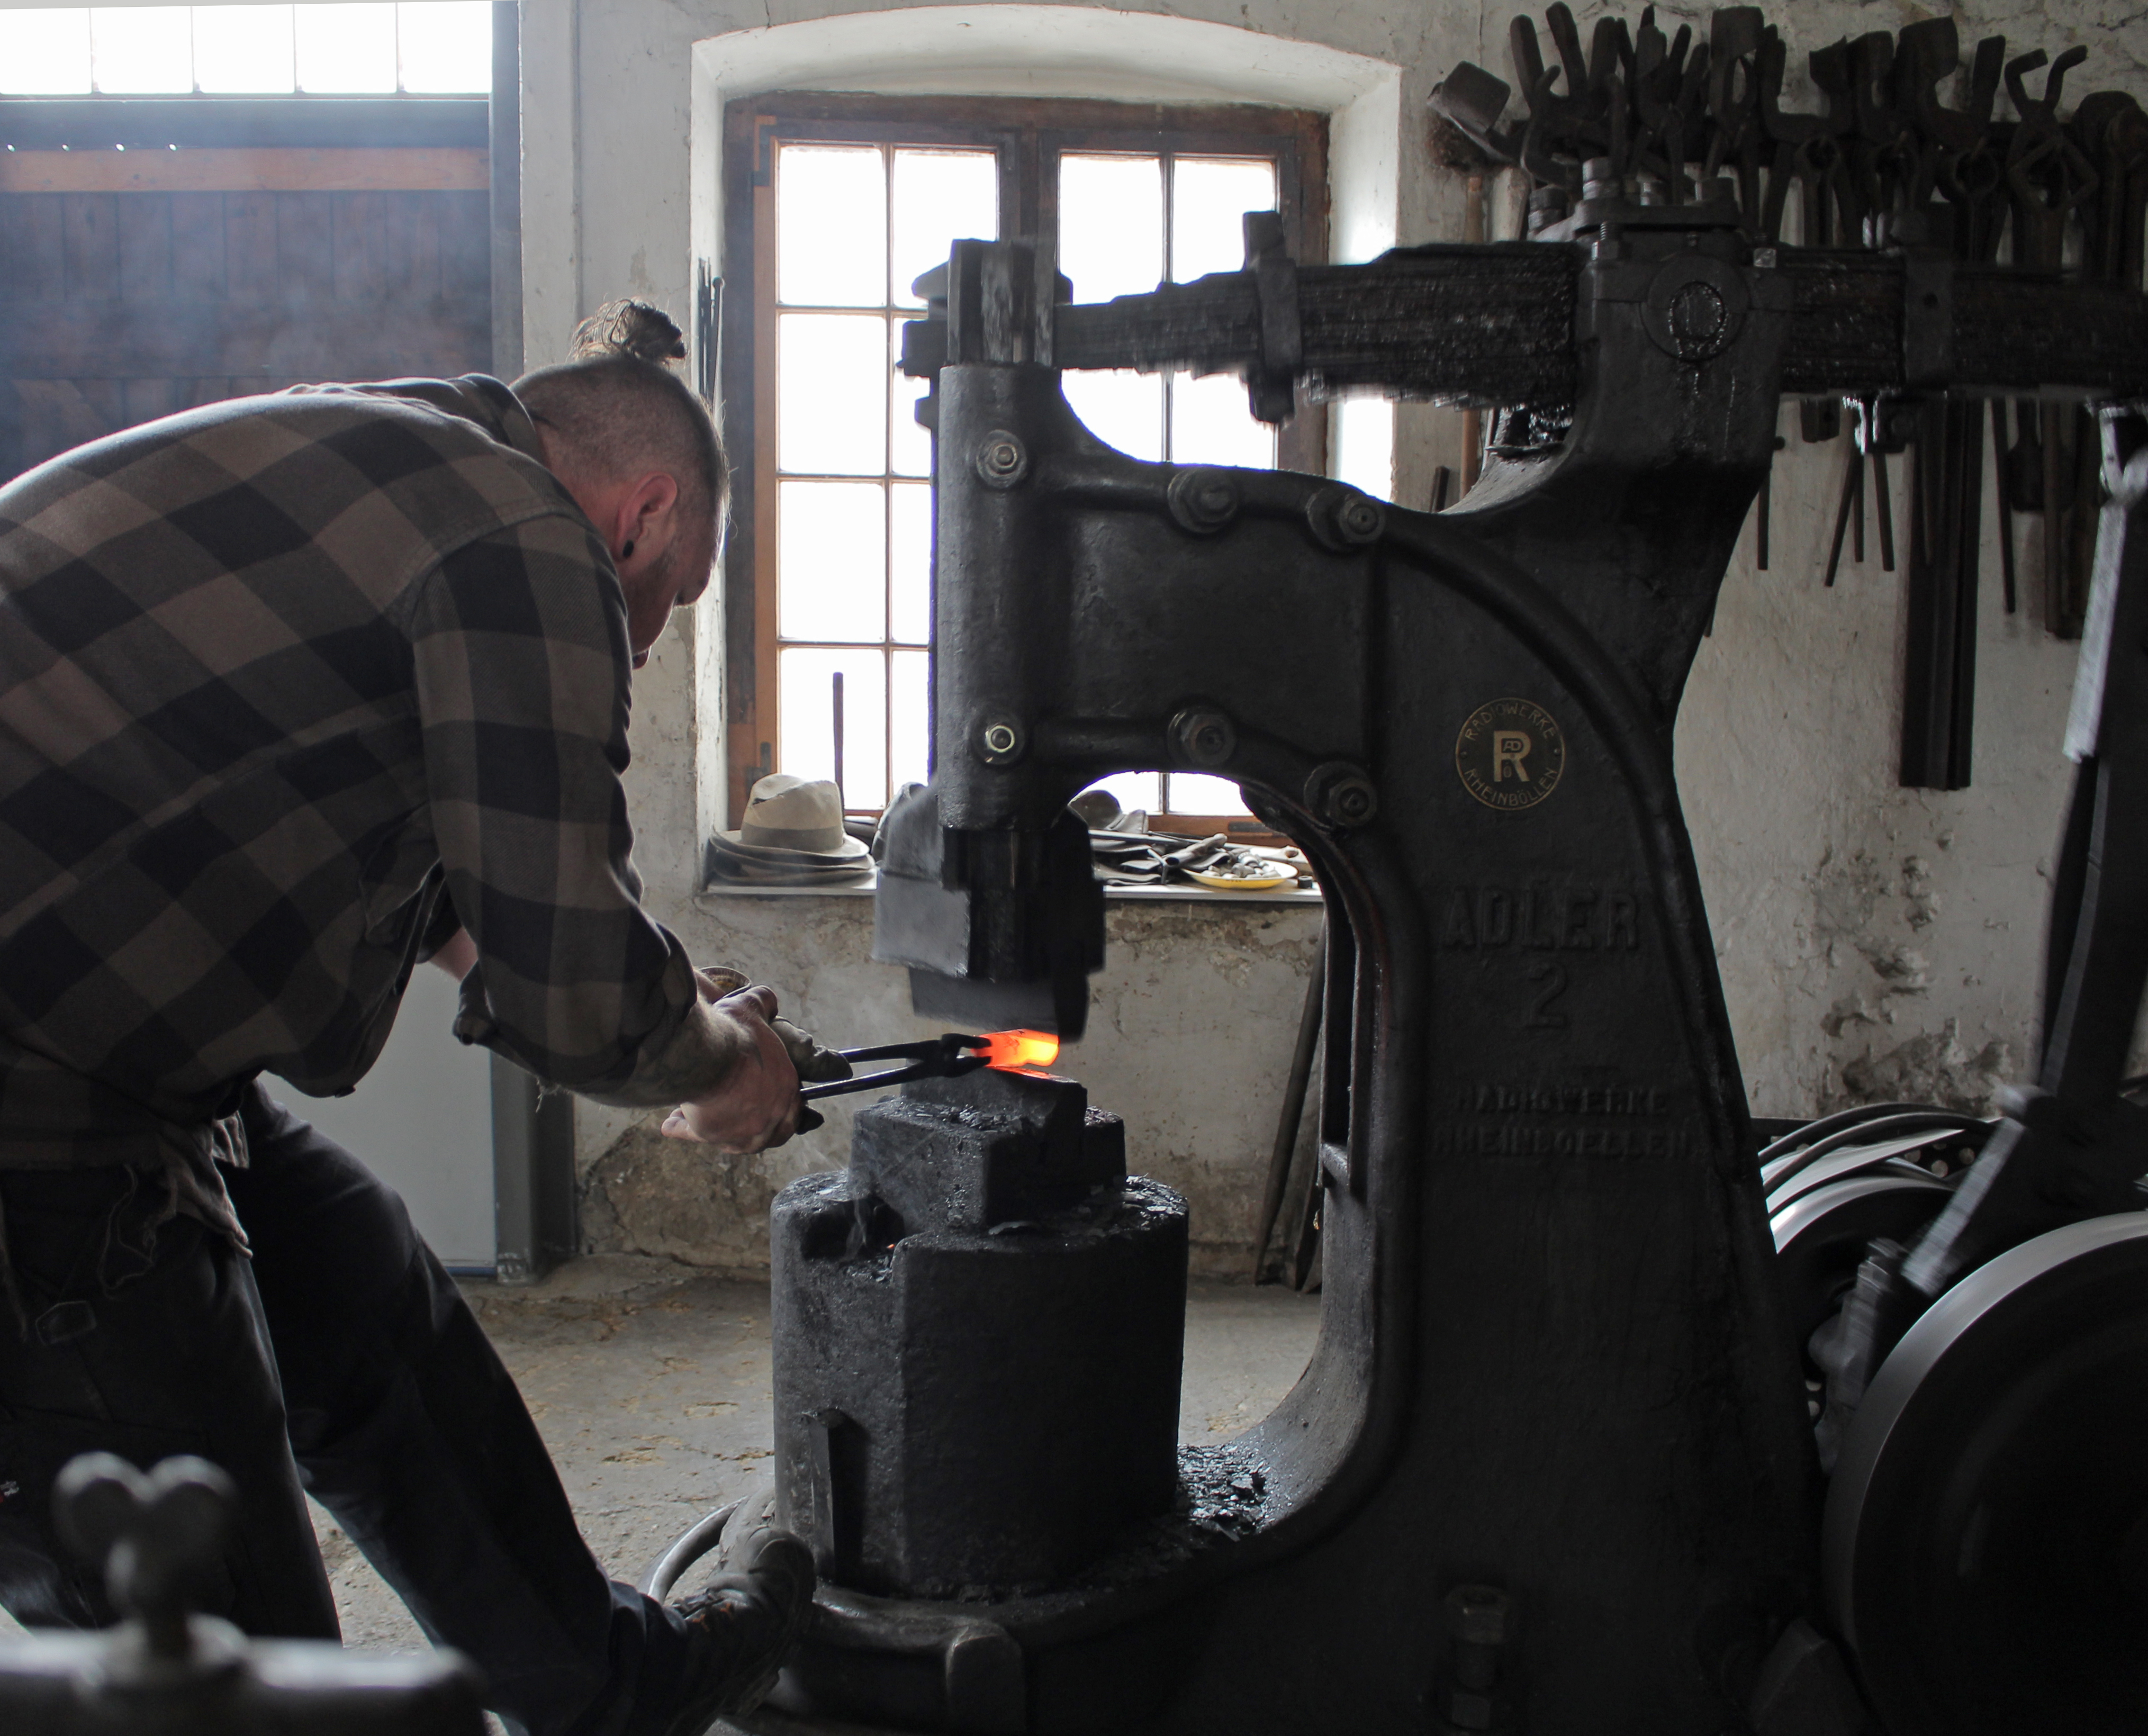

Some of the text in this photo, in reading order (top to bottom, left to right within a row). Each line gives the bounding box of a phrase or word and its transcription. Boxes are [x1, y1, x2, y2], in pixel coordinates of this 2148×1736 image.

[1465, 703, 1554, 740] RADIOWERKE
[1465, 768, 1557, 807] RHEINBÖLLEN
[1443, 884, 1639, 951] ADLER
[1524, 961, 1569, 1029] 2
